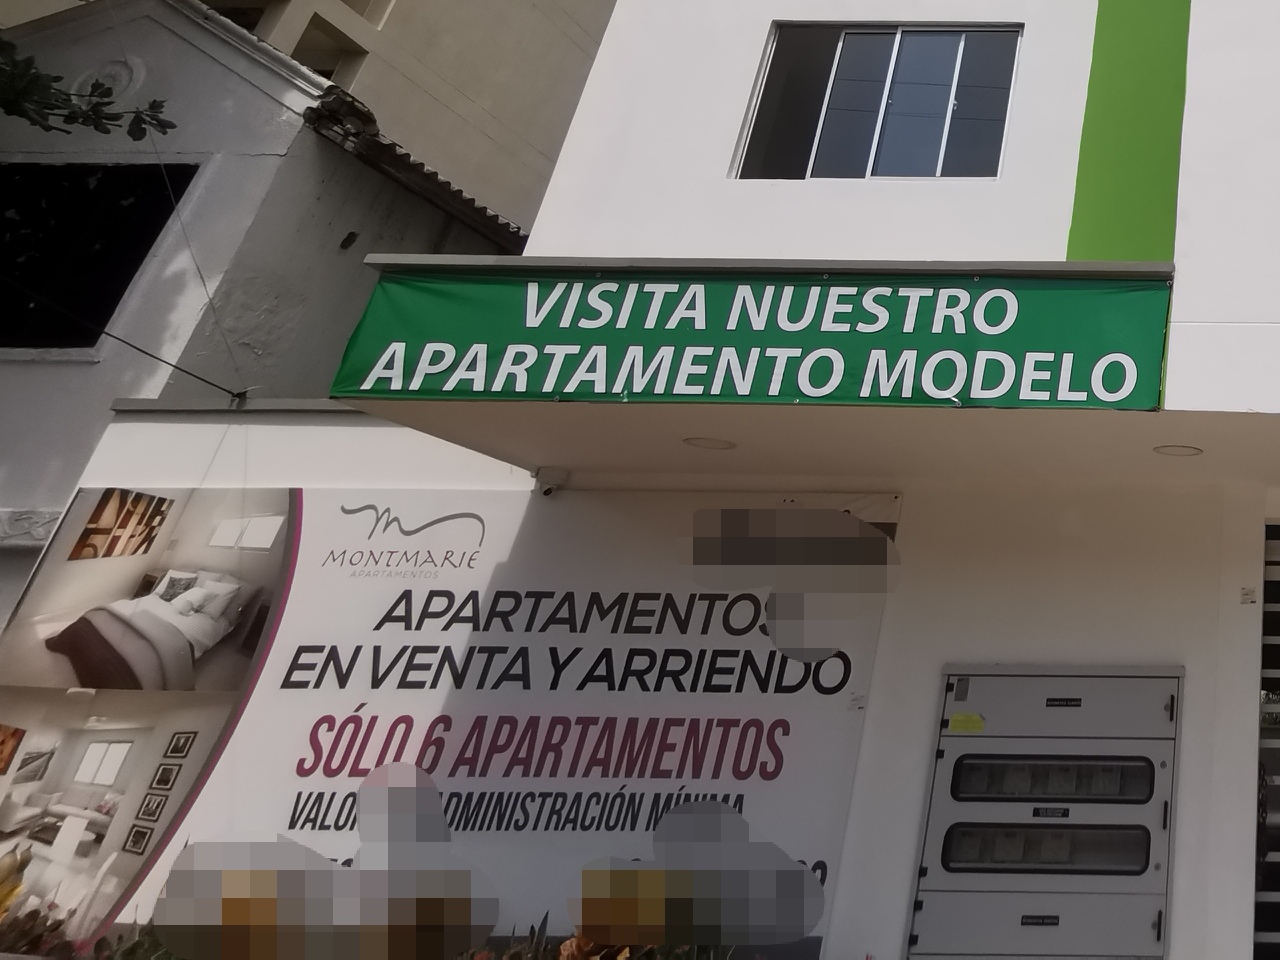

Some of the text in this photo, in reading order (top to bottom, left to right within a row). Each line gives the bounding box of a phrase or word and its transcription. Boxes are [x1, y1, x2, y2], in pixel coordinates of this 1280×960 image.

[524, 281, 1020, 335] VISITA NUESTRO
[359, 341, 1139, 402] APARTAMENTO MODELO
[321, 548, 481, 569] MONTMARIE
[349, 569, 440, 580] APARTAMENTOS
[372, 589, 770, 637] APARTAMENTO
[280, 644, 853, 696] EN VENTA Y ARRIENDO
[295, 702, 792, 782] SÓLO 6 APARTAMENTOS
[287, 791, 357, 832] VALO
[439, 784, 646, 832] DMINISTRACIÓN
